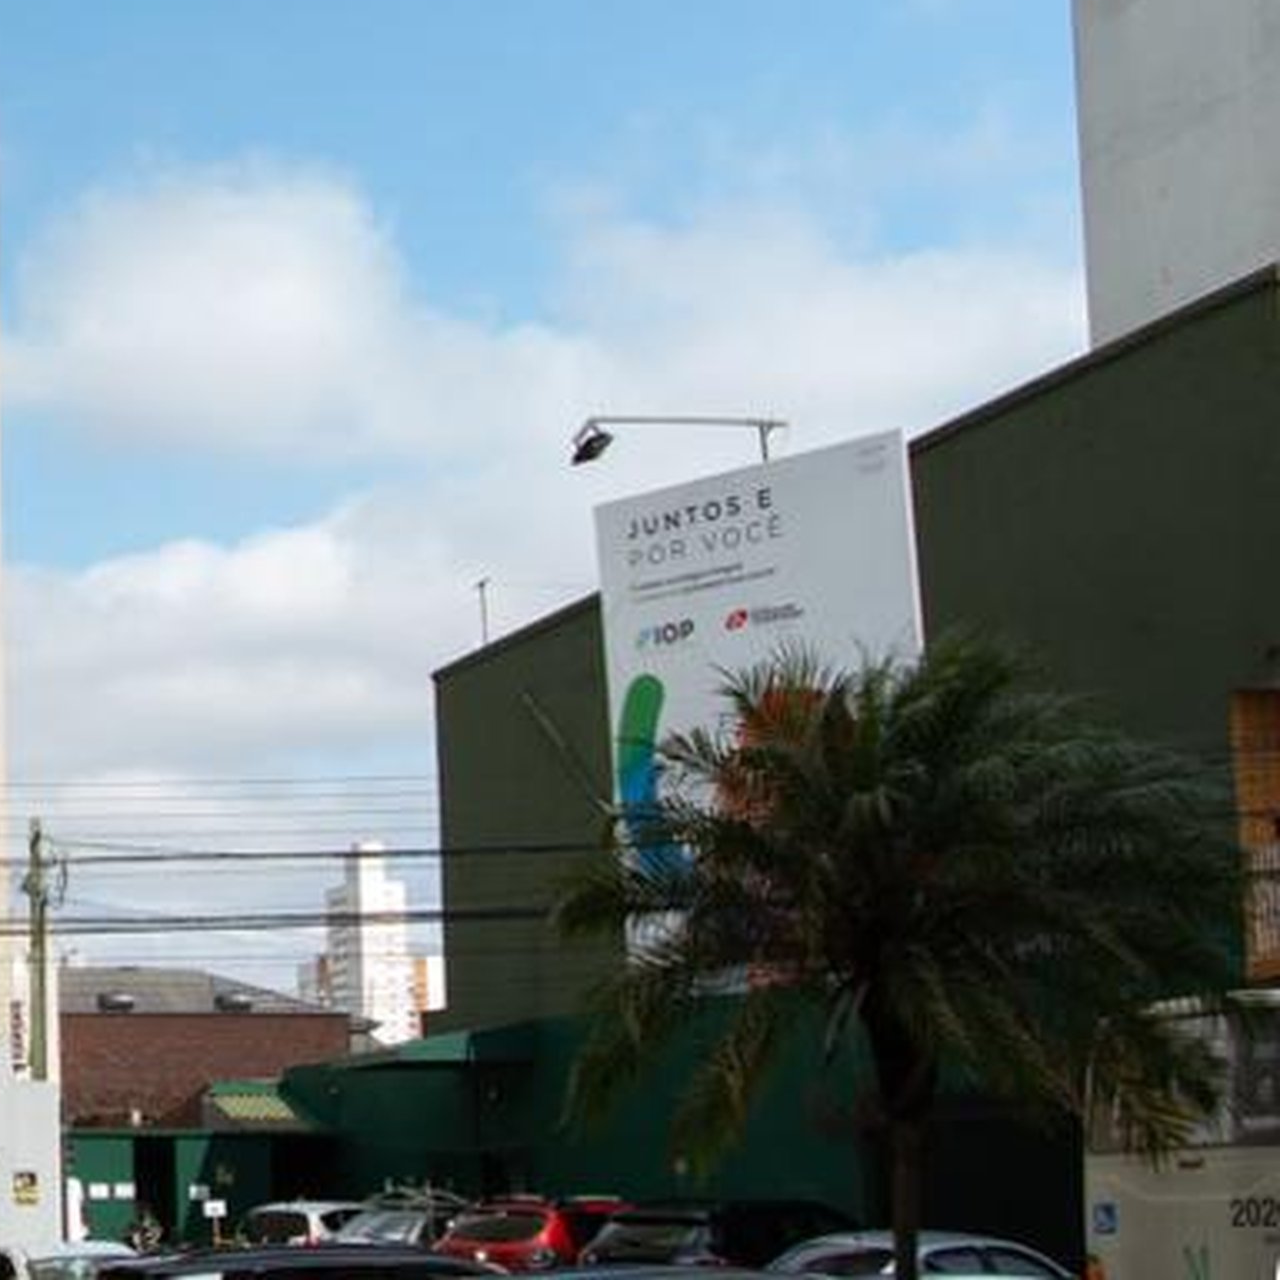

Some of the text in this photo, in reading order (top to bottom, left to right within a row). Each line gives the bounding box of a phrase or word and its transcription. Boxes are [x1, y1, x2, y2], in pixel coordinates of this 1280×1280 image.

[626, 488, 773, 540] JUNTOS E
[627, 511, 784, 568] POR VOCÊ
[1229, 1197, 1280, 1228] 202
